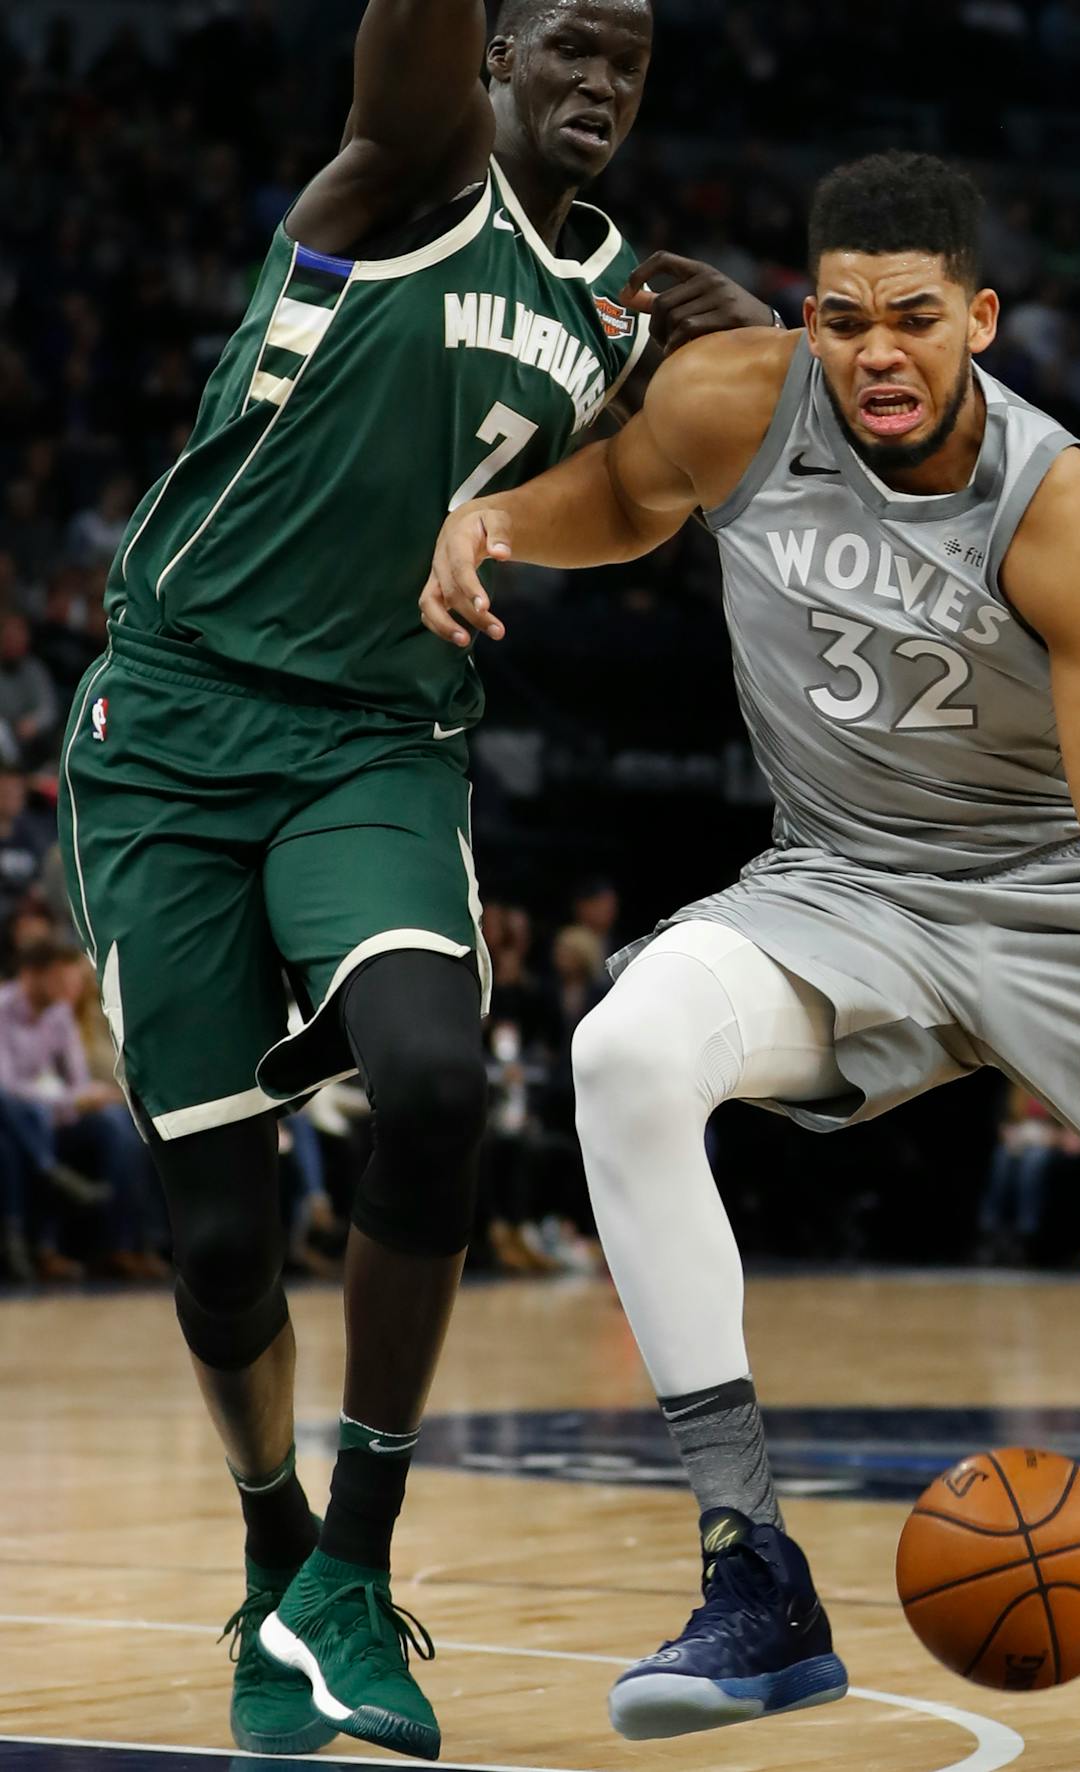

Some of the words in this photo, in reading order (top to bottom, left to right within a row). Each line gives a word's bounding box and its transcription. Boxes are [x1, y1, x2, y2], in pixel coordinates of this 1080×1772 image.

[448, 401, 539, 512] 7
[766, 529, 1010, 645] WOLVES
[804, 608, 978, 733] 32
